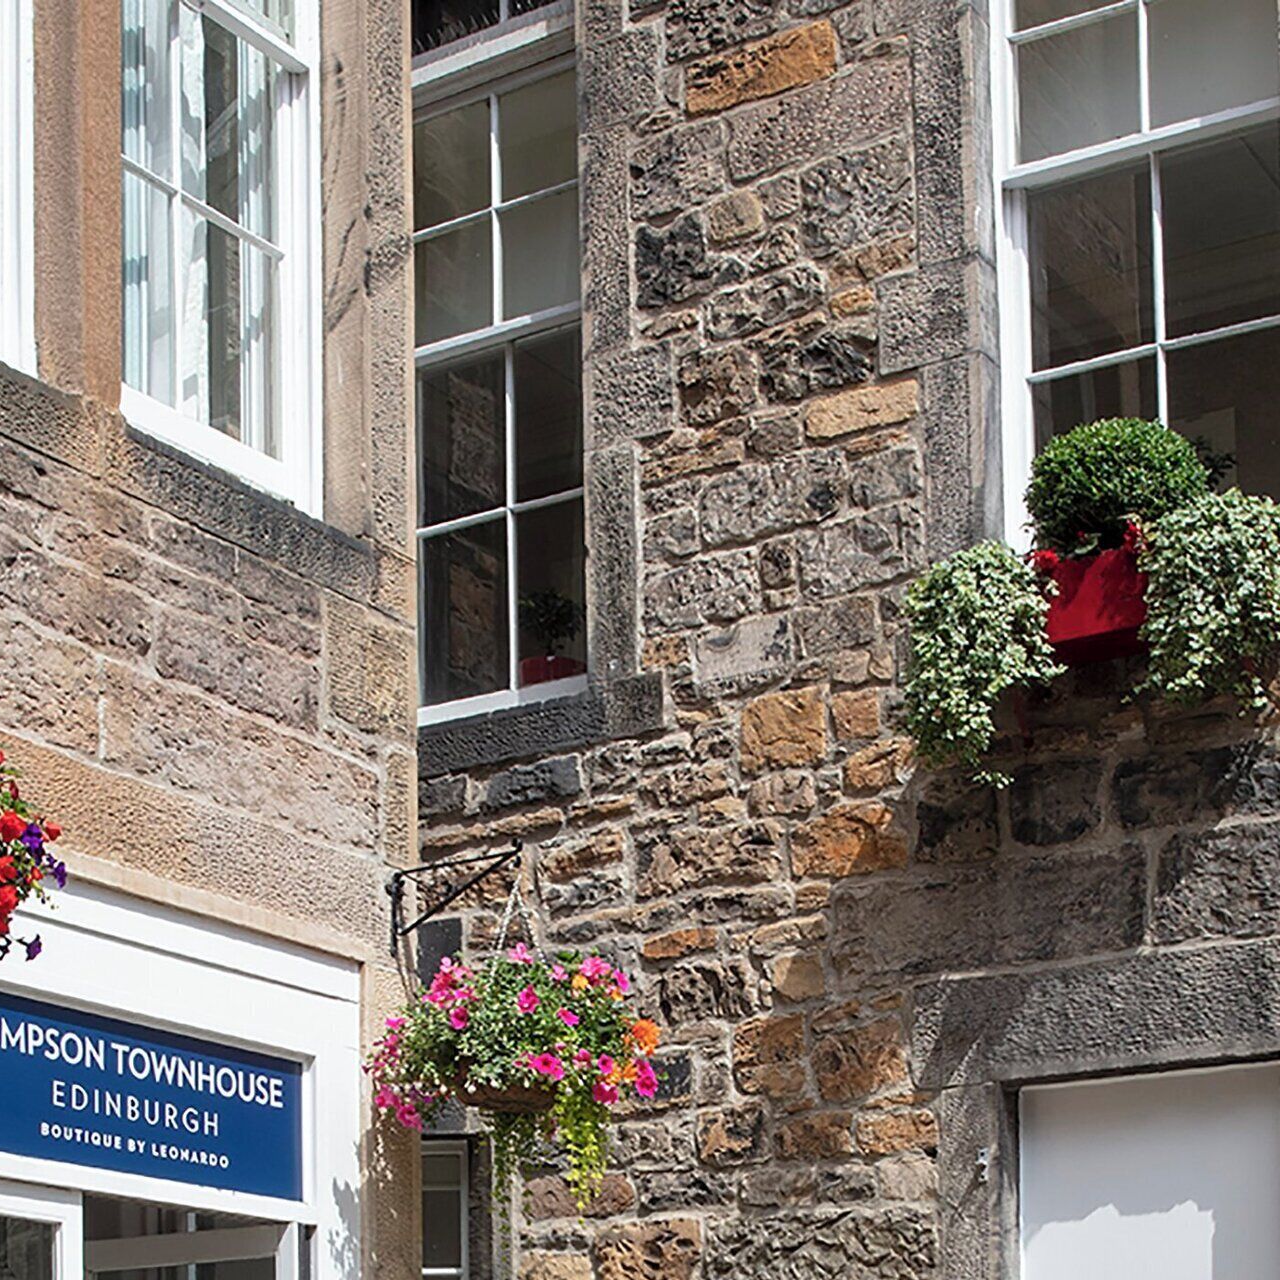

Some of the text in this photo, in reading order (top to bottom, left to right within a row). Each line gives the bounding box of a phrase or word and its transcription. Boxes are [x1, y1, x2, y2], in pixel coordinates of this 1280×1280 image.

[111, 1042, 284, 1108] TOWNHOUSE
[52, 1080, 219, 1136] EDINBURGH
[40, 1122, 230, 1169] BOUTIQUE BY LEONARDO
